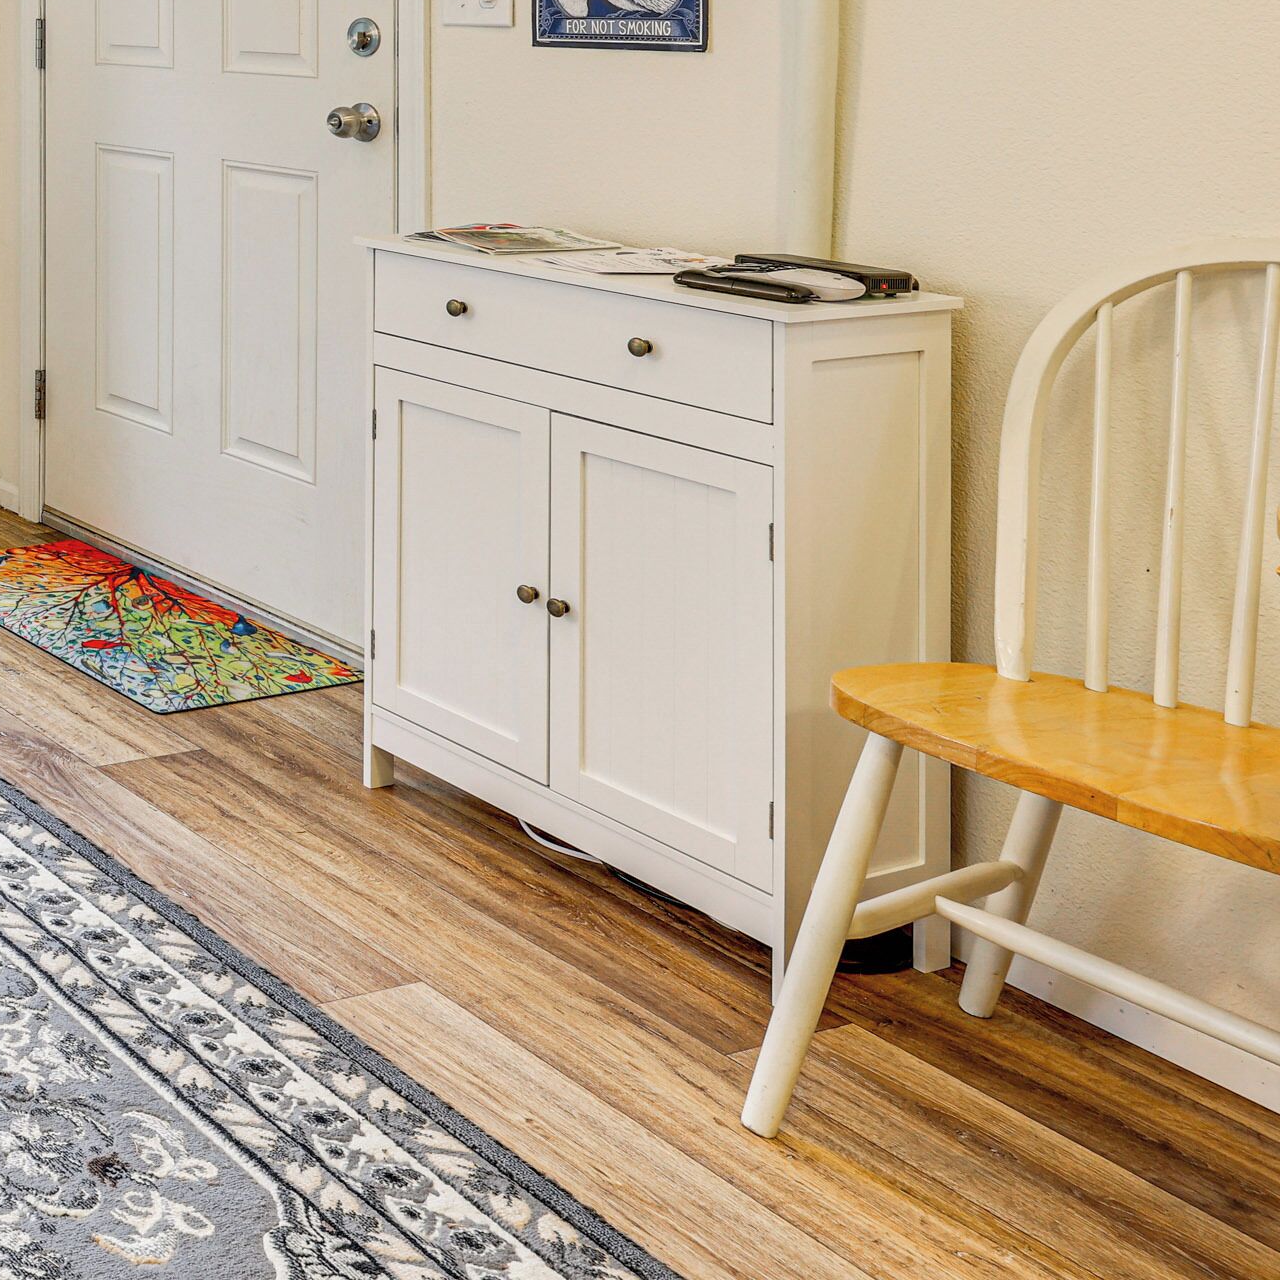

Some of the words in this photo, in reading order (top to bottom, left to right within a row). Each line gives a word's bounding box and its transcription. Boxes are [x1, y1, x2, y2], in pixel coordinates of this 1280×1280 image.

[566, 19, 587, 35] FOR
[591, 19, 616, 35] NOT
[618, 20, 672, 36] SMOKING
